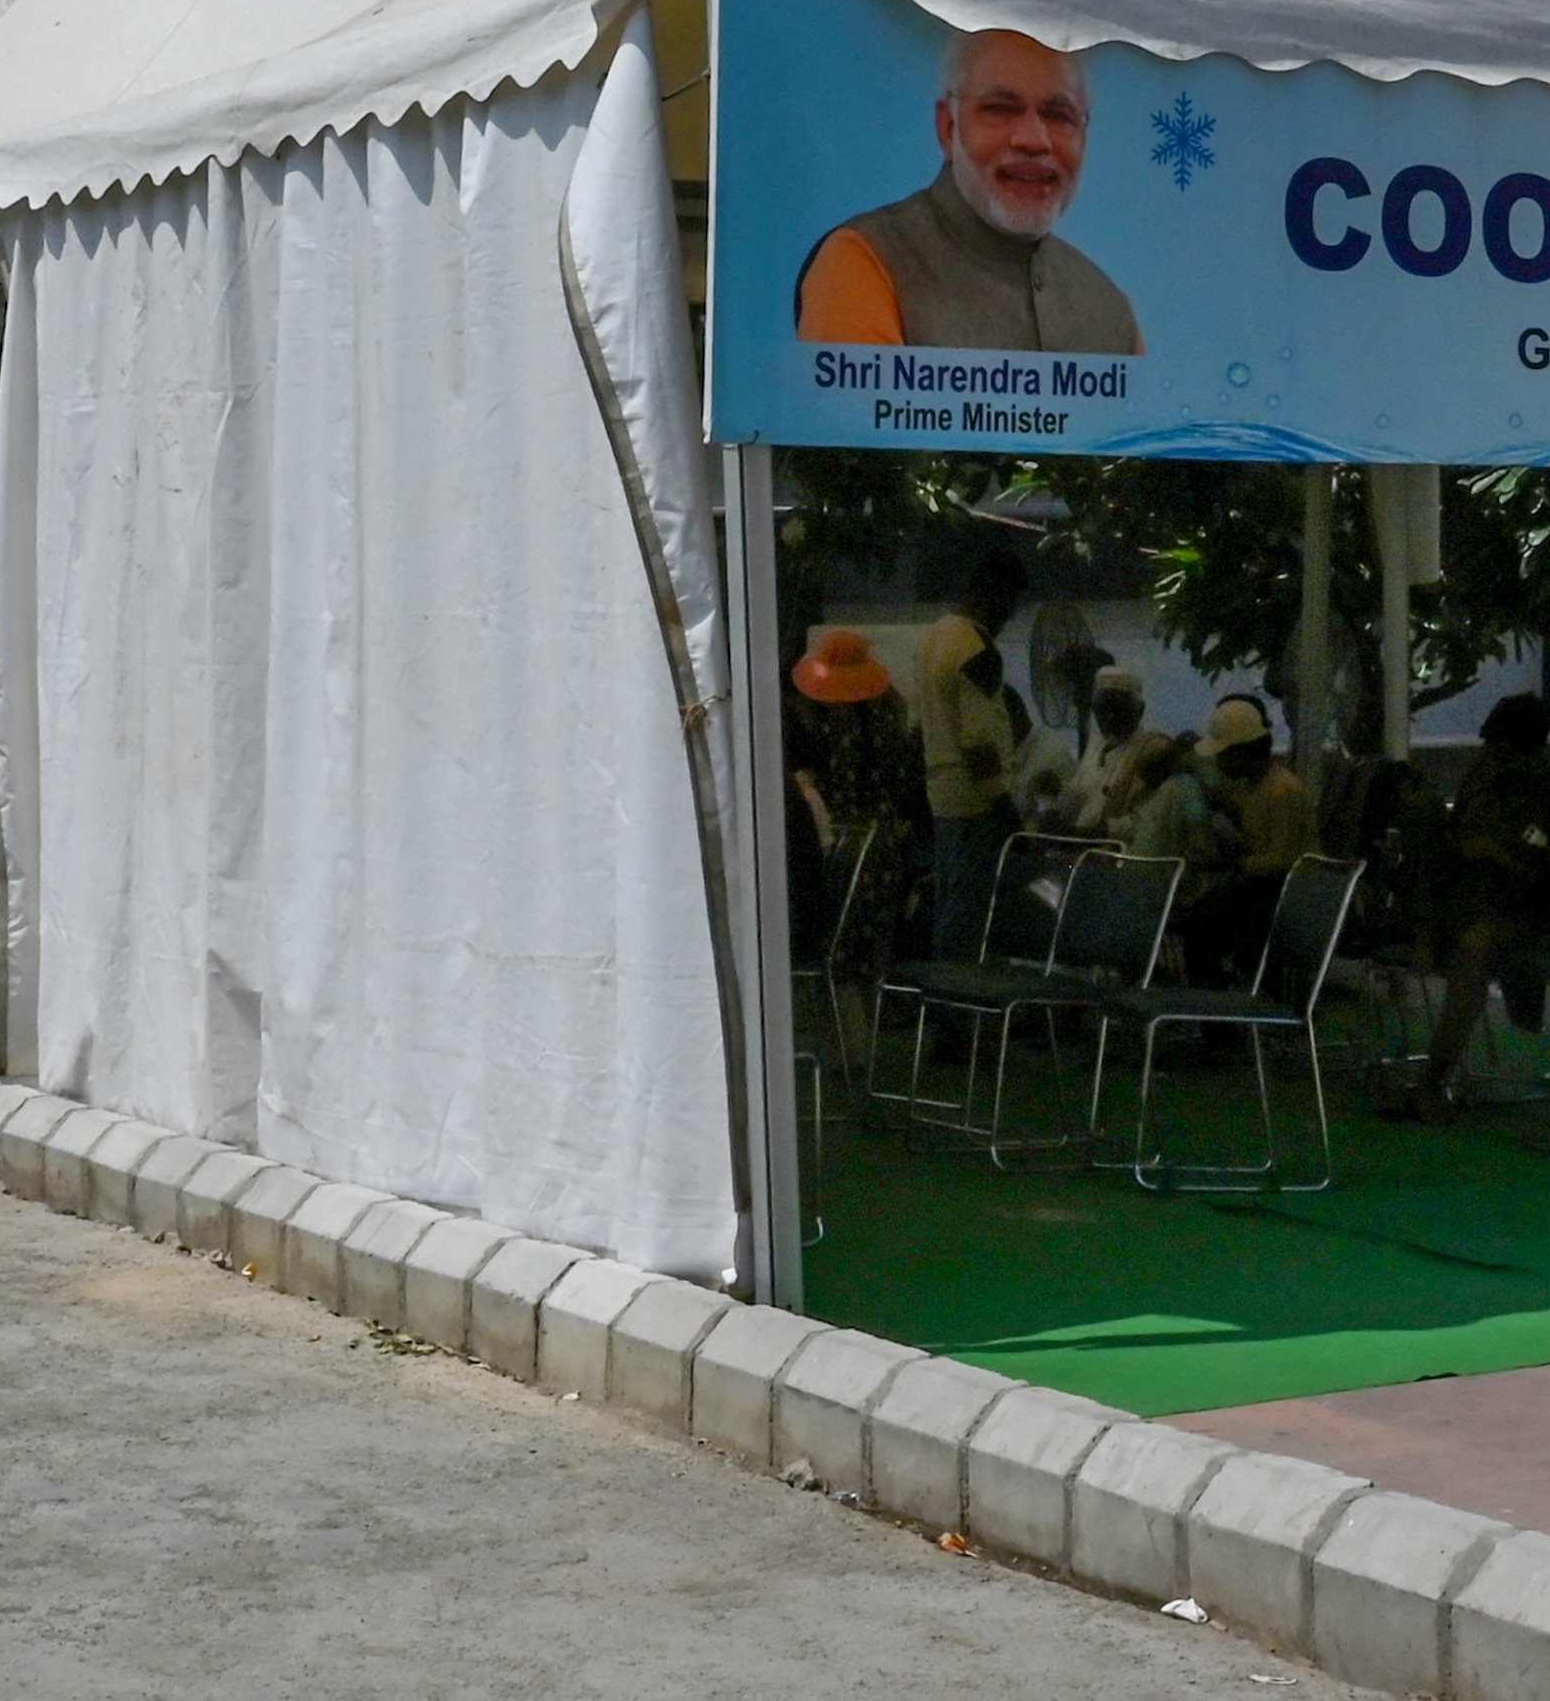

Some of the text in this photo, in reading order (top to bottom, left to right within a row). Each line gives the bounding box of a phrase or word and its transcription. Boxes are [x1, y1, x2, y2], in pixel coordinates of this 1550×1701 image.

[815, 351, 1126, 398] Shri Narendra Modi
[875, 399, 1068, 434] Prime Minister
